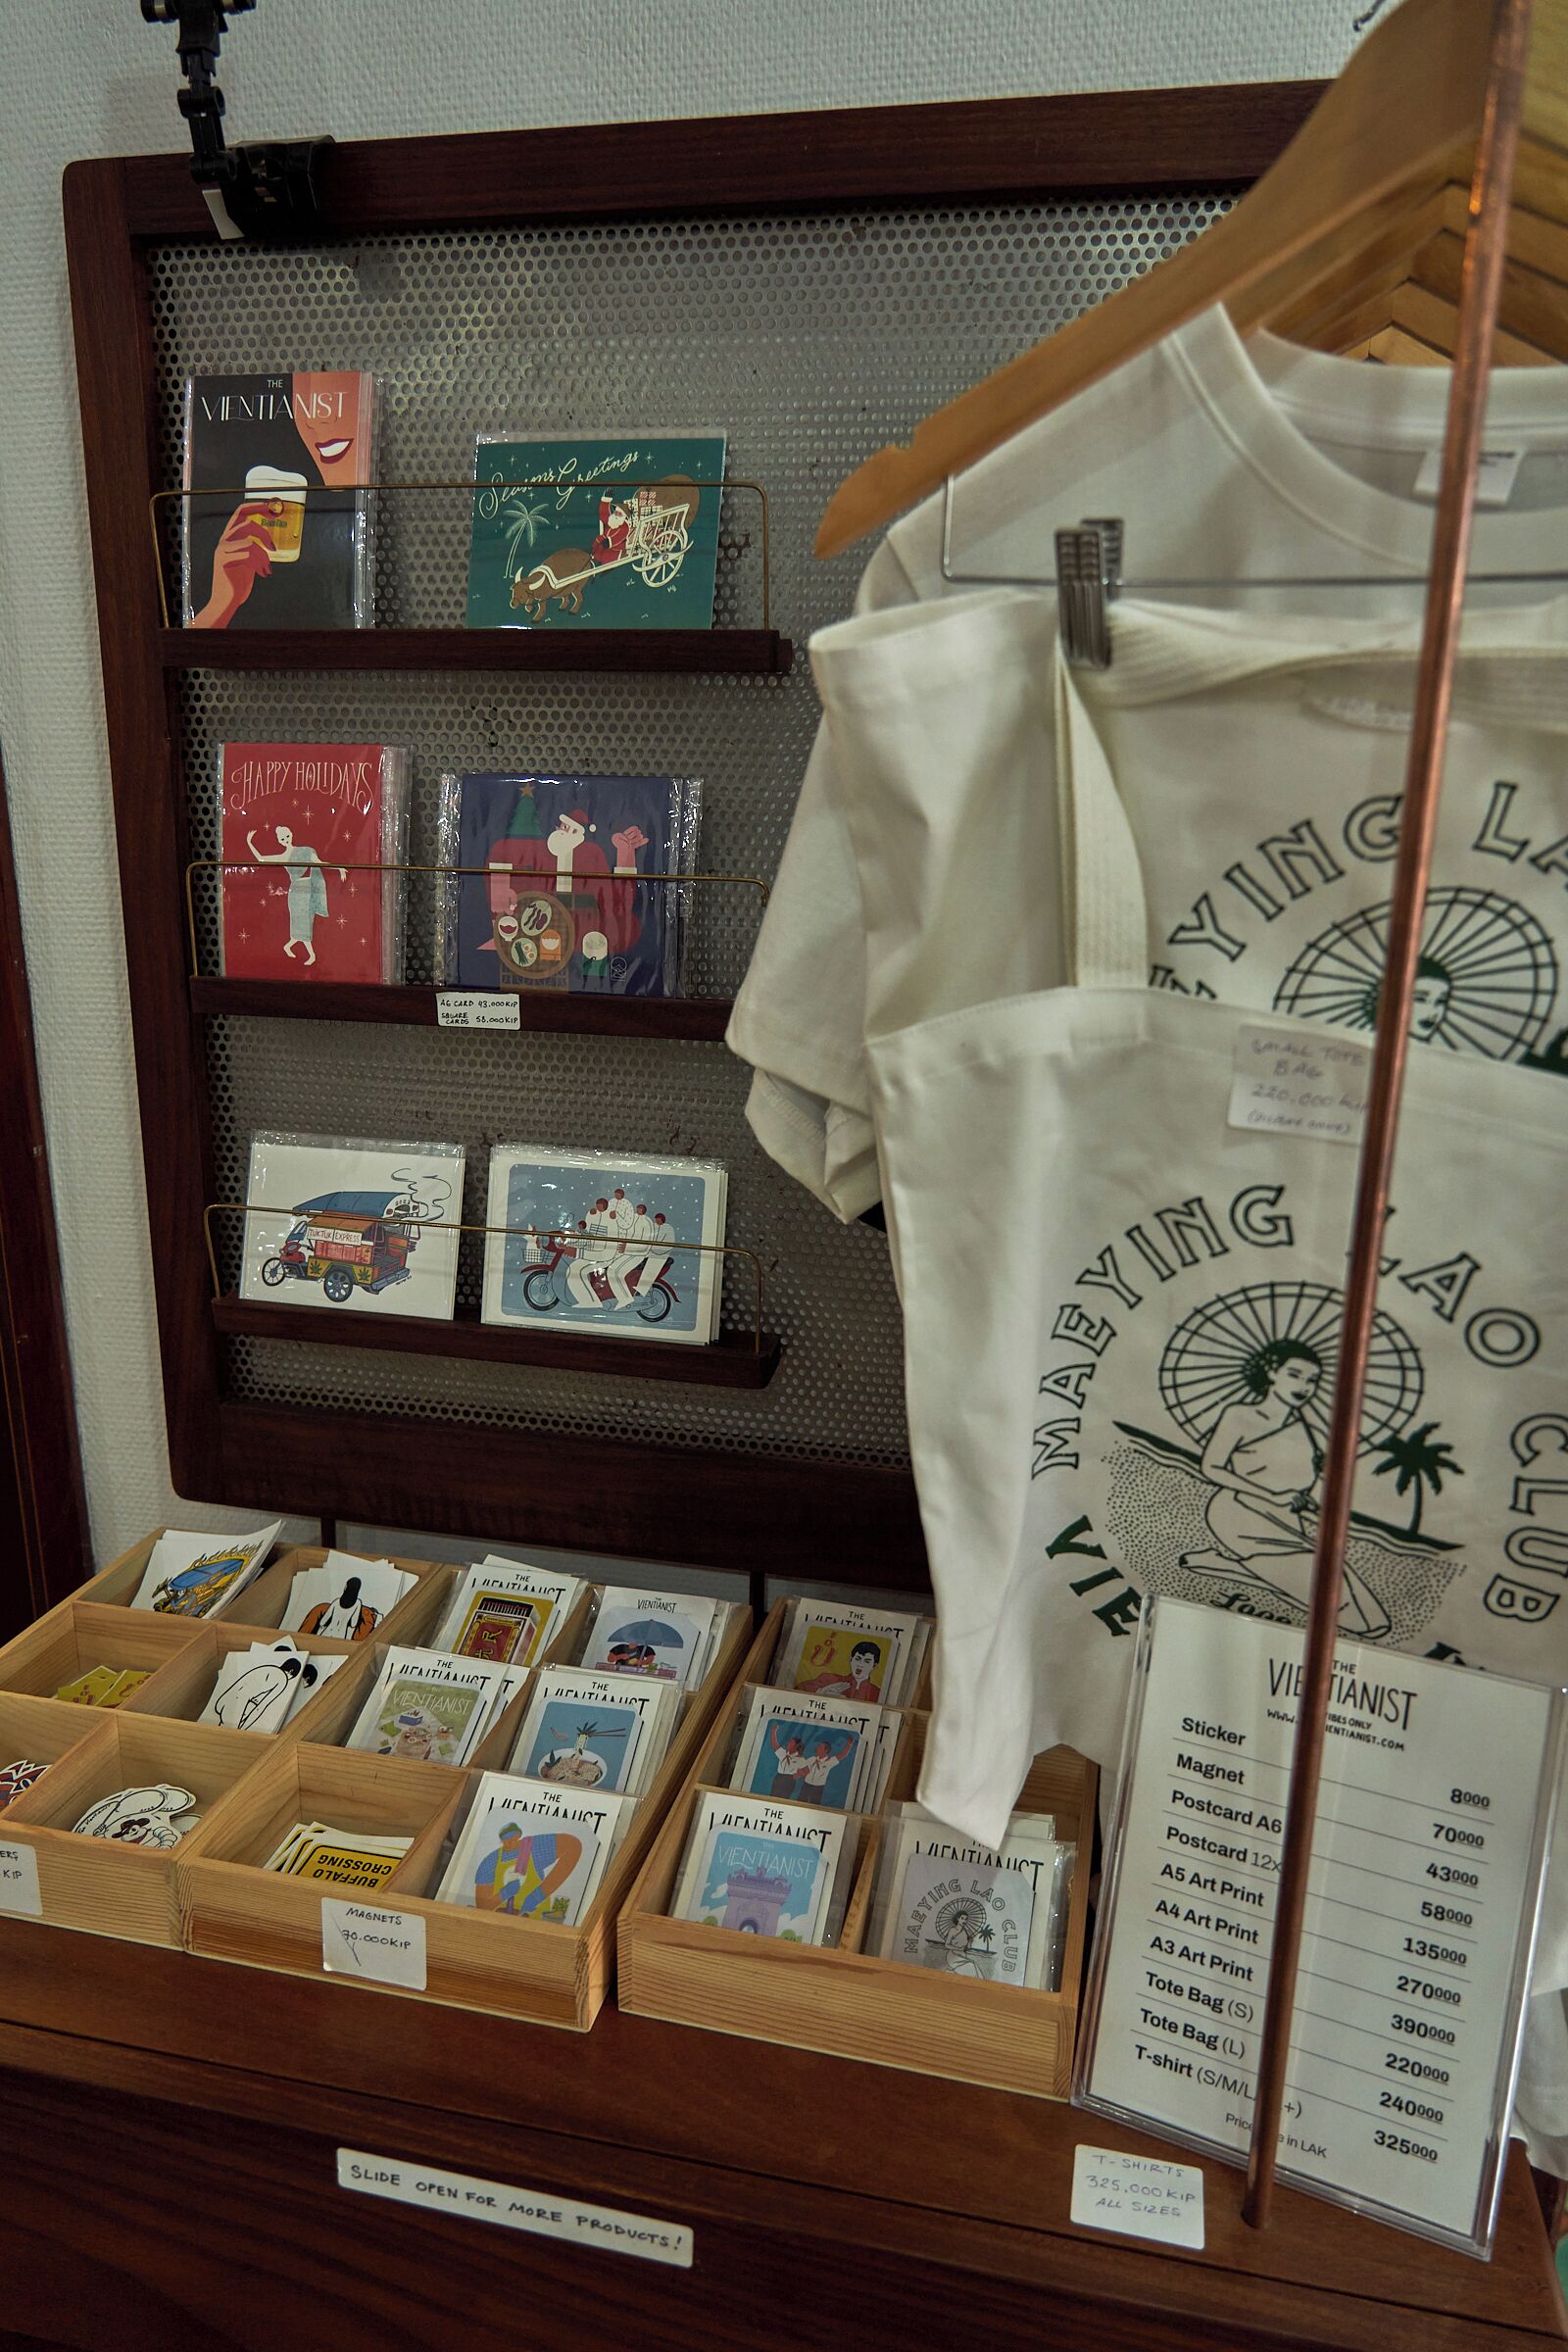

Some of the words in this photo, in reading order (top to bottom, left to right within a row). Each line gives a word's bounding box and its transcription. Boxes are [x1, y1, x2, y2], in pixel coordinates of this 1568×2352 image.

[267, 379, 283, 388] THE
[201, 392, 348, 421] VIENTIANIST
[230, 760, 292, 809] HAPPY
[294, 761, 373, 814] HOLIDAYS
[335, 1234, 361, 1244] EXPRESS
[1032, 1185, 1295, 1480] MAEYING
[1482, 1413, 1568, 1623] CLUB
[514, 1574, 530, 1583] THE
[637, 1599, 677, 1613] VIENTIANIST
[849, 1611, 865, 1620] THE
[437, 1659, 454, 1669] THE
[1332, 1660, 1357, 1675] THE
[592, 1682, 610, 1691] THE
[1269, 1658, 1418, 1731] VIETIANIST
[393, 1689, 473, 1715] VIENTIANIST
[808, 1699, 827, 1710] THE
[1182, 1717, 1247, 1745] Sticker
[1326, 1713, 1347, 1725] IBES
[1348, 1719, 1372, 1731] ONLY
[1176, 1753, 1246, 1785] Magnet
[543, 1791, 563, 1802] THE
[764, 1807, 784, 1820] THE
[1171, 1789, 1253, 1825] Postcard
[1255, 1815, 1283, 1834] A6
[718, 1844, 814, 1879] VIENTIANIST
[1166, 1826, 1249, 1862] Postcard
[1251, 1851, 1283, 1873] 12x
[3, 1870, 23, 1880] KIP
[313, 1868, 379, 1887] BUFFALO
[318, 1854, 393, 1876] CROSSING
[1160, 1863, 1186, 1882] A5
[1189, 1873, 1217, 1892] Art
[1220, 1881, 1264, 1907] Print
[345, 1907, 402, 1925] MAGNETS
[905, 1879, 961, 1953] MAEYING
[970, 1880, 1005, 1911] LAO
[1002, 1919, 1018, 1973] CLUB
[1155, 1899, 1181, 1918] A4
[1183, 1909, 1212, 1929] Art
[1215, 1918, 1259, 1944] Print
[1150, 1936, 1175, 1955] A3
[1178, 1945, 1206, 1966] Art
[1209, 1954, 1253, 1982] Print
[1146, 1971, 1184, 1996] Tote
[1188, 1985, 1225, 2014] Bag
[1227, 1999, 1253, 2023] (S)
[1140, 2008, 1179, 2034] Tote
[1182, 2022, 1219, 2051] Bag
[1222, 2036, 1246, 2059] (L)
[1135, 2044, 1193, 2078] T-shirt
[1226, 2113, 1254, 2132] Price
[1286, 2134, 1298, 2148] in
[1300, 2138, 1327, 2158] LAK
[351, 2165, 400, 2185] SLIDE
[416, 2181, 459, 2198] OPEN
[465, 2191, 497, 2207] FOR
[509, 2202, 563, 2223] MORE
[575, 2215, 682, 2251] PRODUCTS!
[1096, 2197, 1122, 2209] ALL
[1131, 2201, 1181, 2216] SIZES
